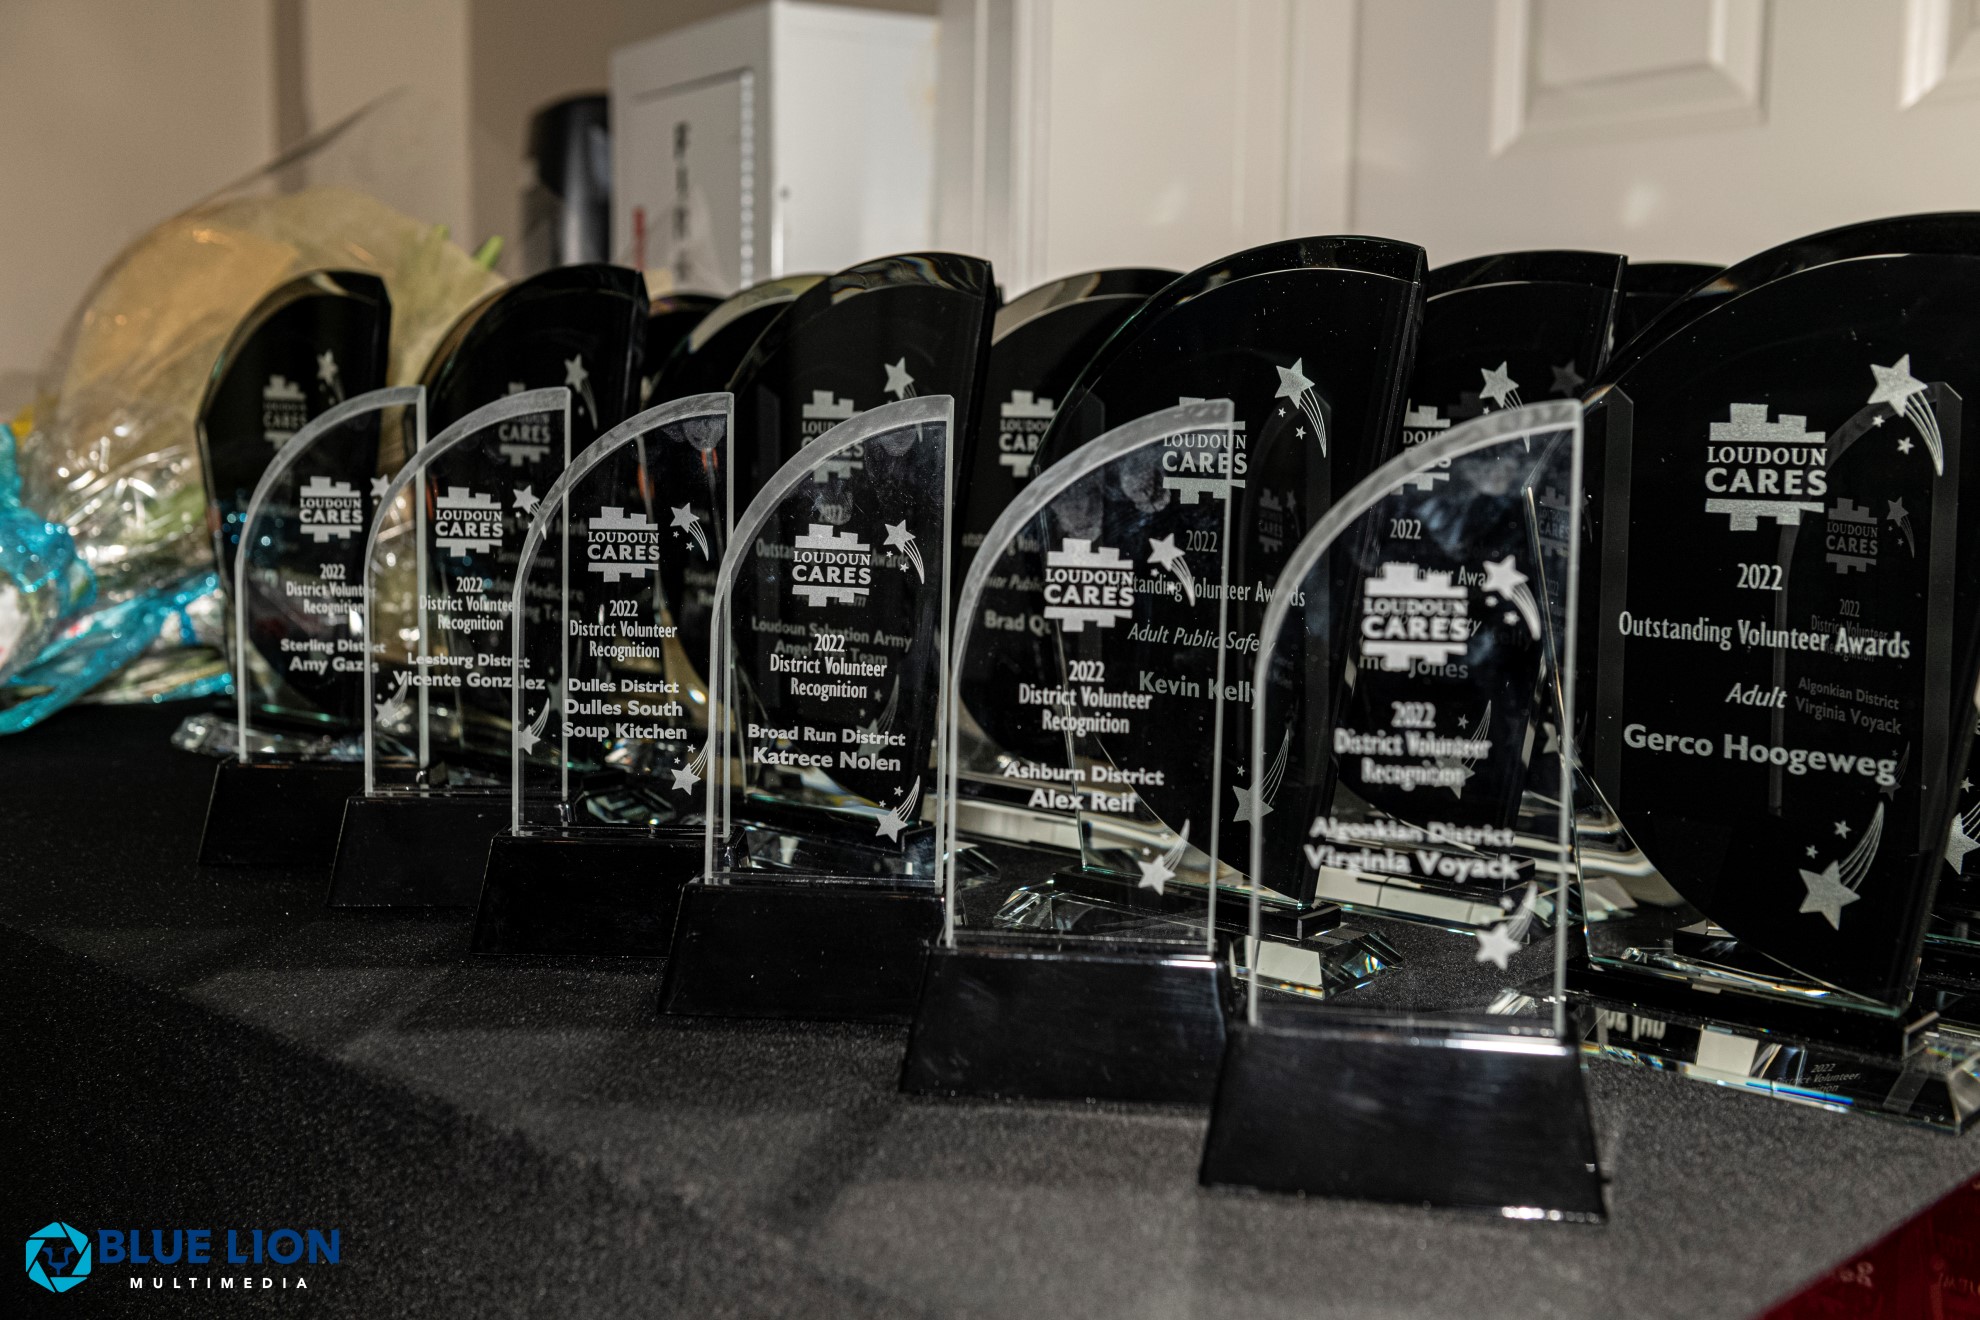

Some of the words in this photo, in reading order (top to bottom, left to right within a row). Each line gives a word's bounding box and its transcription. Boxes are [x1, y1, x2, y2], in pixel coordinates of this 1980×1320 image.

[999, 433, 1041, 452] CAR
[1163, 433, 1247, 450] LOUDOUN
[1161, 451, 1248, 475] CARES
[1706, 446, 1828, 466] LOUDOUN
[1704, 467, 1828, 496] CARES
[300, 497, 362, 510] LOUDOUN
[300, 509, 363, 524] CARES
[435, 509, 503, 522] LOUDOUN
[435, 522, 504, 538] CARES
[588, 531, 660, 544] LOUDOUN
[1389, 518, 1422, 540] 2022
[1826, 520, 1879, 539] LOUDOUN
[586, 543, 661, 561] CARES
[1185, 529, 1218, 553] 2022
[1825, 534, 1879, 556] CARES
[793, 551, 872, 566] LOUDOUN
[320, 563, 346, 580] 2022
[791, 565, 872, 585] CARES
[1045, 568, 1134, 586] LOUDOUN
[1736, 562, 1783, 591] 2022
[286, 580, 327, 597] District
[456, 576, 483, 594] 2022
[1043, 584, 1135, 608] CARES
[1255, 580, 1306, 607] Awds
[418, 595, 463, 612] District
[466, 595, 514, 612] Voluntee
[609, 599, 639, 618] 2022
[1363, 597, 1469, 617] LOUDOUN
[1839, 598, 1861, 618] 2022
[437, 613, 504, 634] Recognition
[569, 619, 617, 638] District
[619, 620, 678, 639] Volunteer
[983, 608, 1026, 632] Brad
[1361, 615, 1470, 642] CARES
[752, 615, 806, 638] Loudoun
[873, 629, 914, 653] Army
[813, 633, 846, 652] 2022
[1127, 622, 1169, 645] Adult
[1173, 627, 1220, 650] Public
[1225, 631, 1275, 655] Safe
[1618, 610, 1732, 651] Outstanding
[1737, 619, 1830, 652] Volunteer
[1834, 627, 1911, 659] Awards
[280, 638, 334, 655] Sterling
[336, 638, 386, 654] Distct
[589, 640, 661, 662] Recognition
[289, 655, 328, 675] Amy
[331, 656, 380, 673] Gazs
[407, 652, 474, 670] Leesburg
[477, 653, 531, 669] Distrct
[769, 653, 821, 675] District
[824, 656, 888, 678] Volunteer
[1068, 660, 1106, 683] 2022
[393, 670, 462, 687] Vicente
[466, 672, 546, 691] Gonzlez
[568, 677, 617, 693] Dulles
[620, 679, 680, 694] District
[790, 677, 868, 702] Recognition
[1139, 670, 1200, 698] Kevin
[1208, 678, 1259, 710] Kelly
[1018, 683, 1077, 706] District
[1081, 687, 1153, 711] Volunteer
[1724, 682, 1788, 709] Adult
[1798, 676, 1853, 700] Algonkian
[1855, 688, 1900, 711] District
[564, 699, 623, 716] Dulles
[626, 700, 684, 717] South
[1390, 701, 1437, 728] 2022
[1795, 696, 1847, 721] Virginia
[1850, 707, 1902, 735] Voyack
[561, 722, 610, 742] Soup
[614, 722, 688, 741] Kitchen
[1041, 708, 1131, 738] Recognition
[747, 723, 799, 742] Broad
[803, 727, 837, 743] Run
[841, 729, 906, 747] District
[1333, 727, 1404, 756] District
[1404, 730, 1493, 759] Volunteer
[752, 746, 834, 768] Katrece
[839, 751, 901, 772] Nolen
[1623, 723, 1714, 757] Gerco
[1723, 733, 1898, 787] Hoogeweg
[1002, 765, 1086, 783] Ashburn
[1091, 766, 1165, 787] District
[1360, 757, 1466, 791] Recognition
[1028, 788, 1084, 811] Alex
[1091, 792, 1139, 813] Reif
[1309, 816, 1424, 843] Algonkian
[1426, 821, 1515, 847] District
[1303, 844, 1412, 874] Virginia
[1415, 850, 1521, 883] Voyack
